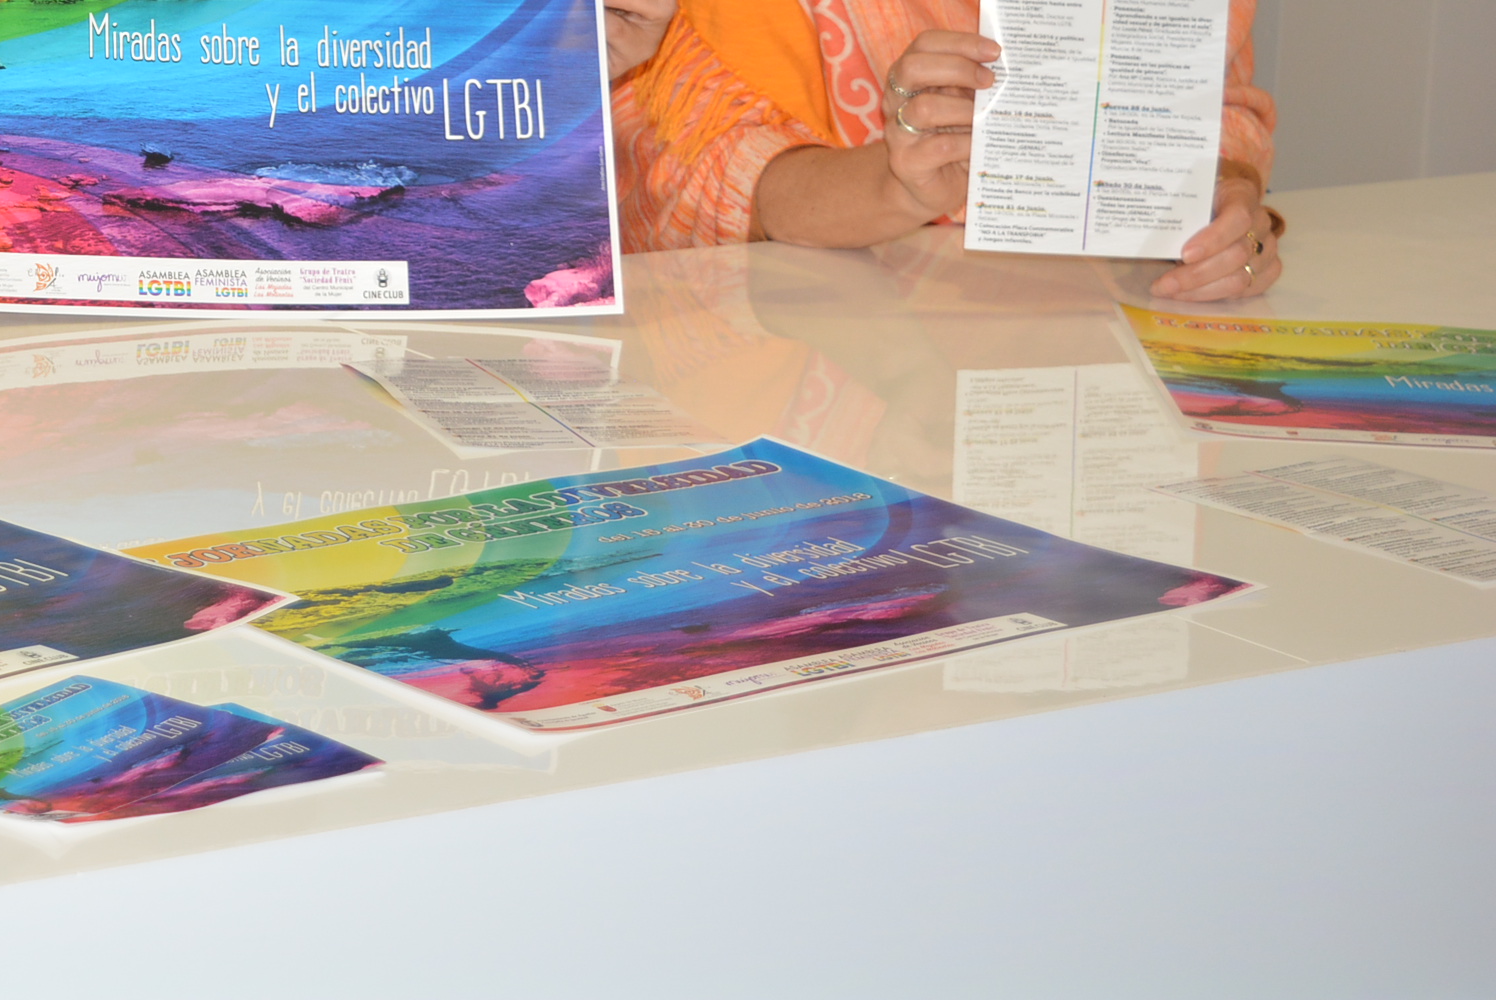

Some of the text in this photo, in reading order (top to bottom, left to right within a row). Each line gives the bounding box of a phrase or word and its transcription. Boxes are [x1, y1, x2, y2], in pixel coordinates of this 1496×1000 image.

[88, 11, 432, 70] Miradas sobre la diversidad
[265, 71, 546, 141] y el colectivo LGTBI
[139, 270, 190, 280] ASAMBLEA
[195, 269, 247, 279] ASAMBLEA
[195, 277, 247, 287] FEMINISTA
[139, 279, 191, 297] LGTBI
[215, 287, 248, 298] LGTBI
[363, 290, 404, 300] CINE CLUB
[1383, 374, 1495, 394] Miradas
[167, 518, 404, 570] JORNADAS
[530, 459, 783, 509] DIVERSIDAD
[598, 534, 630, 544] del
[662, 524, 685, 534] al
[683, 518, 717, 530] 30
[715, 513, 743, 525] de
[740, 505, 795, 523] junio
[794, 498, 821, 511] de
[499, 535, 867, 610] Miradas sobre la diversidad
[730, 534, 1031, 597] y el colectivo LGTBI
[147, 714, 203, 740] LGTBI
[253, 739, 311, 761] LGTBI
